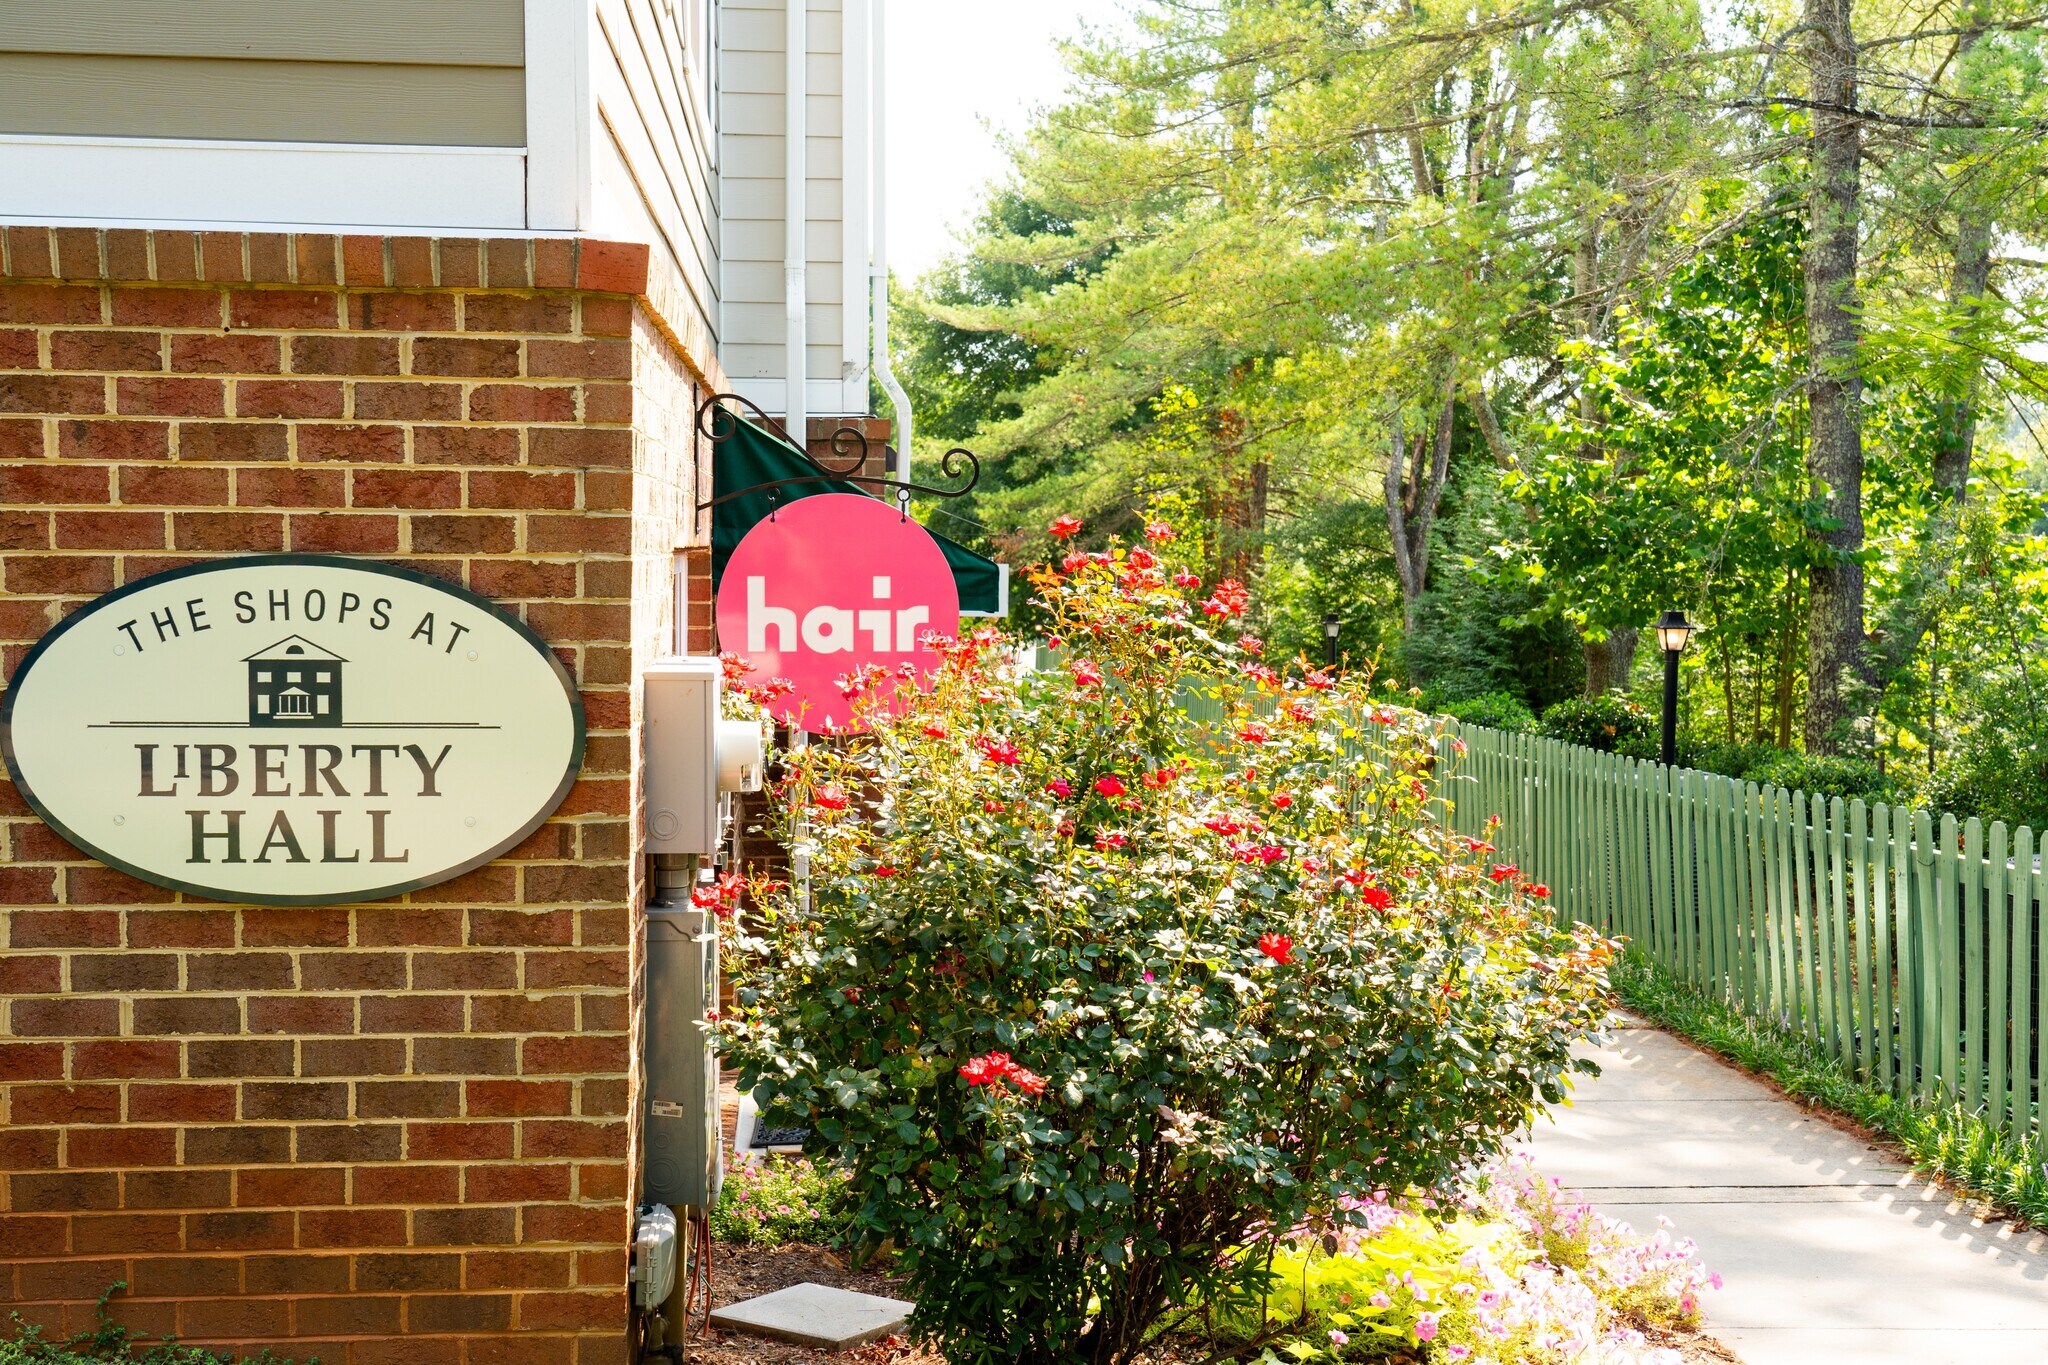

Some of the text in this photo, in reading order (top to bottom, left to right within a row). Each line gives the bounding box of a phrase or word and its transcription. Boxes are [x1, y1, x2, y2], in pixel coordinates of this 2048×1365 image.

[116, 588, 470, 654] THE SHOPS AT
[747, 576, 930, 653] hair
[134, 743, 453, 797] LIBERTY
[185, 810, 409, 864] HALL
